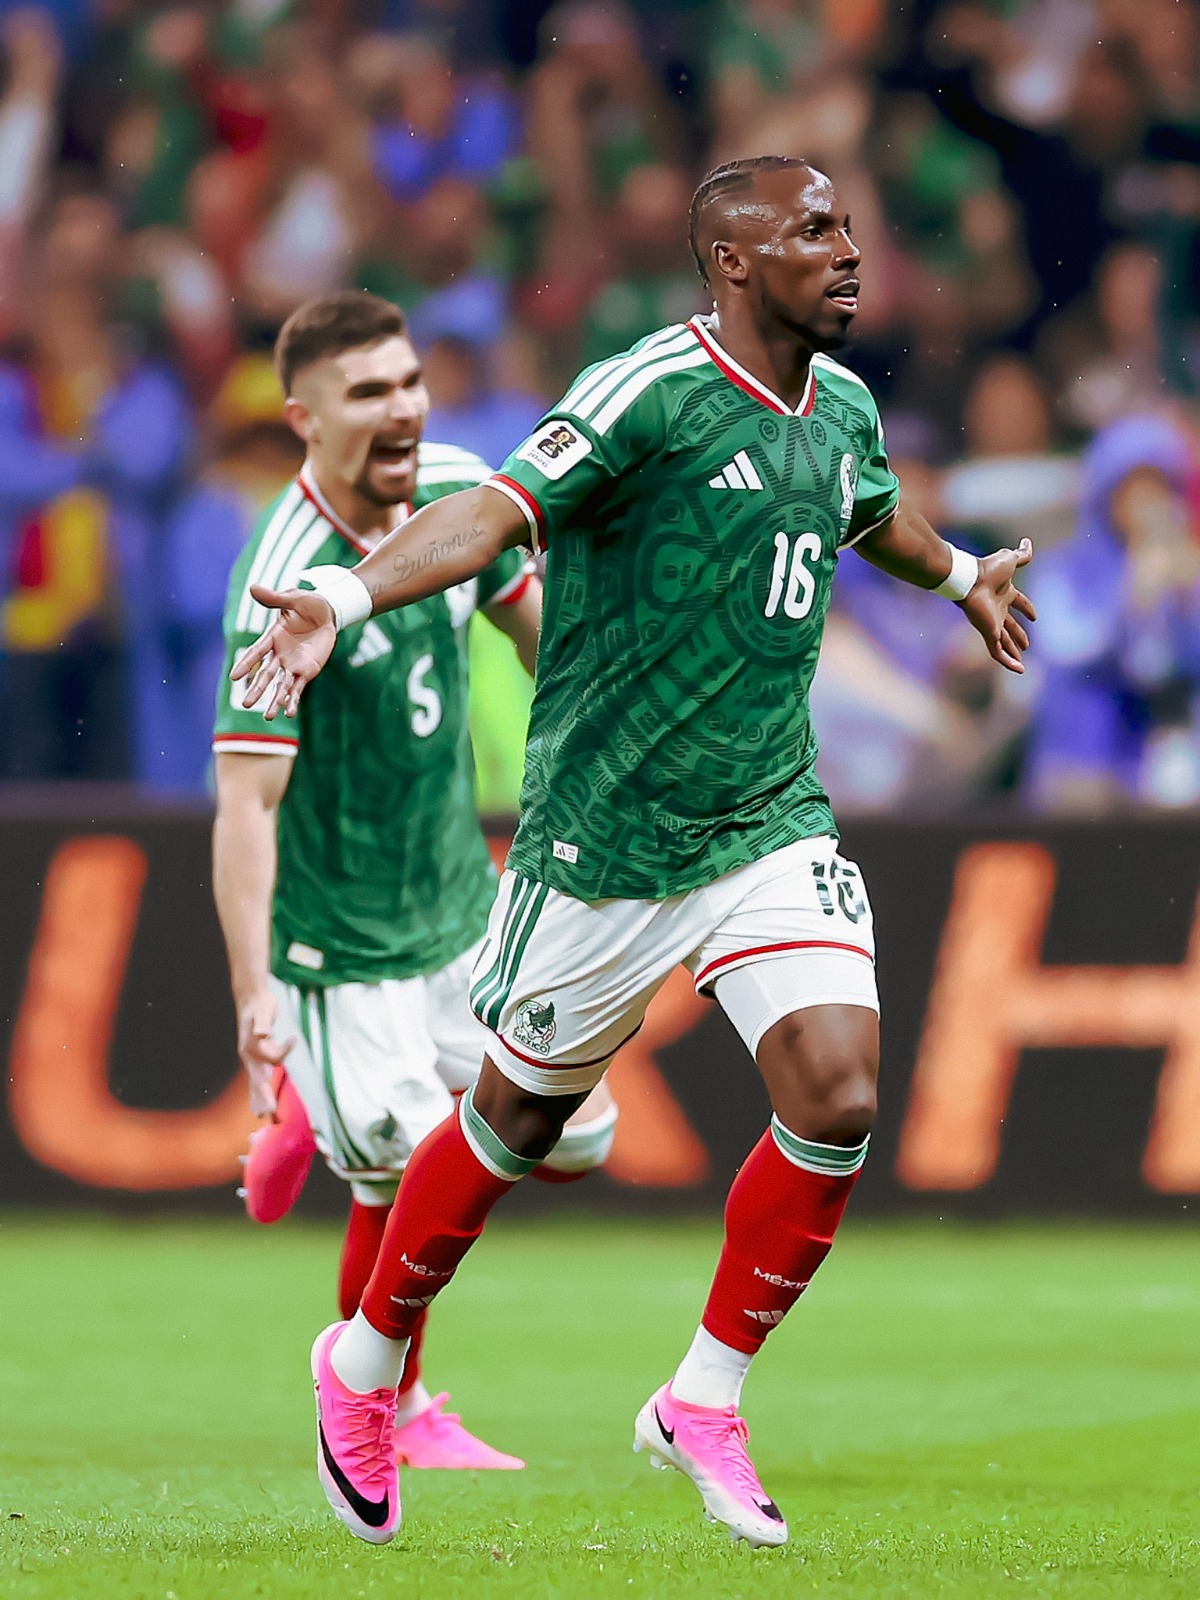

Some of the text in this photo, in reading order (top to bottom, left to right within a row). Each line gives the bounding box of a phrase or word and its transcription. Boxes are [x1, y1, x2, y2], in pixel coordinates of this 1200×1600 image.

[764, 531, 822, 619] 16
[407, 654, 442, 737] 5
[811, 859, 866, 924] 16
